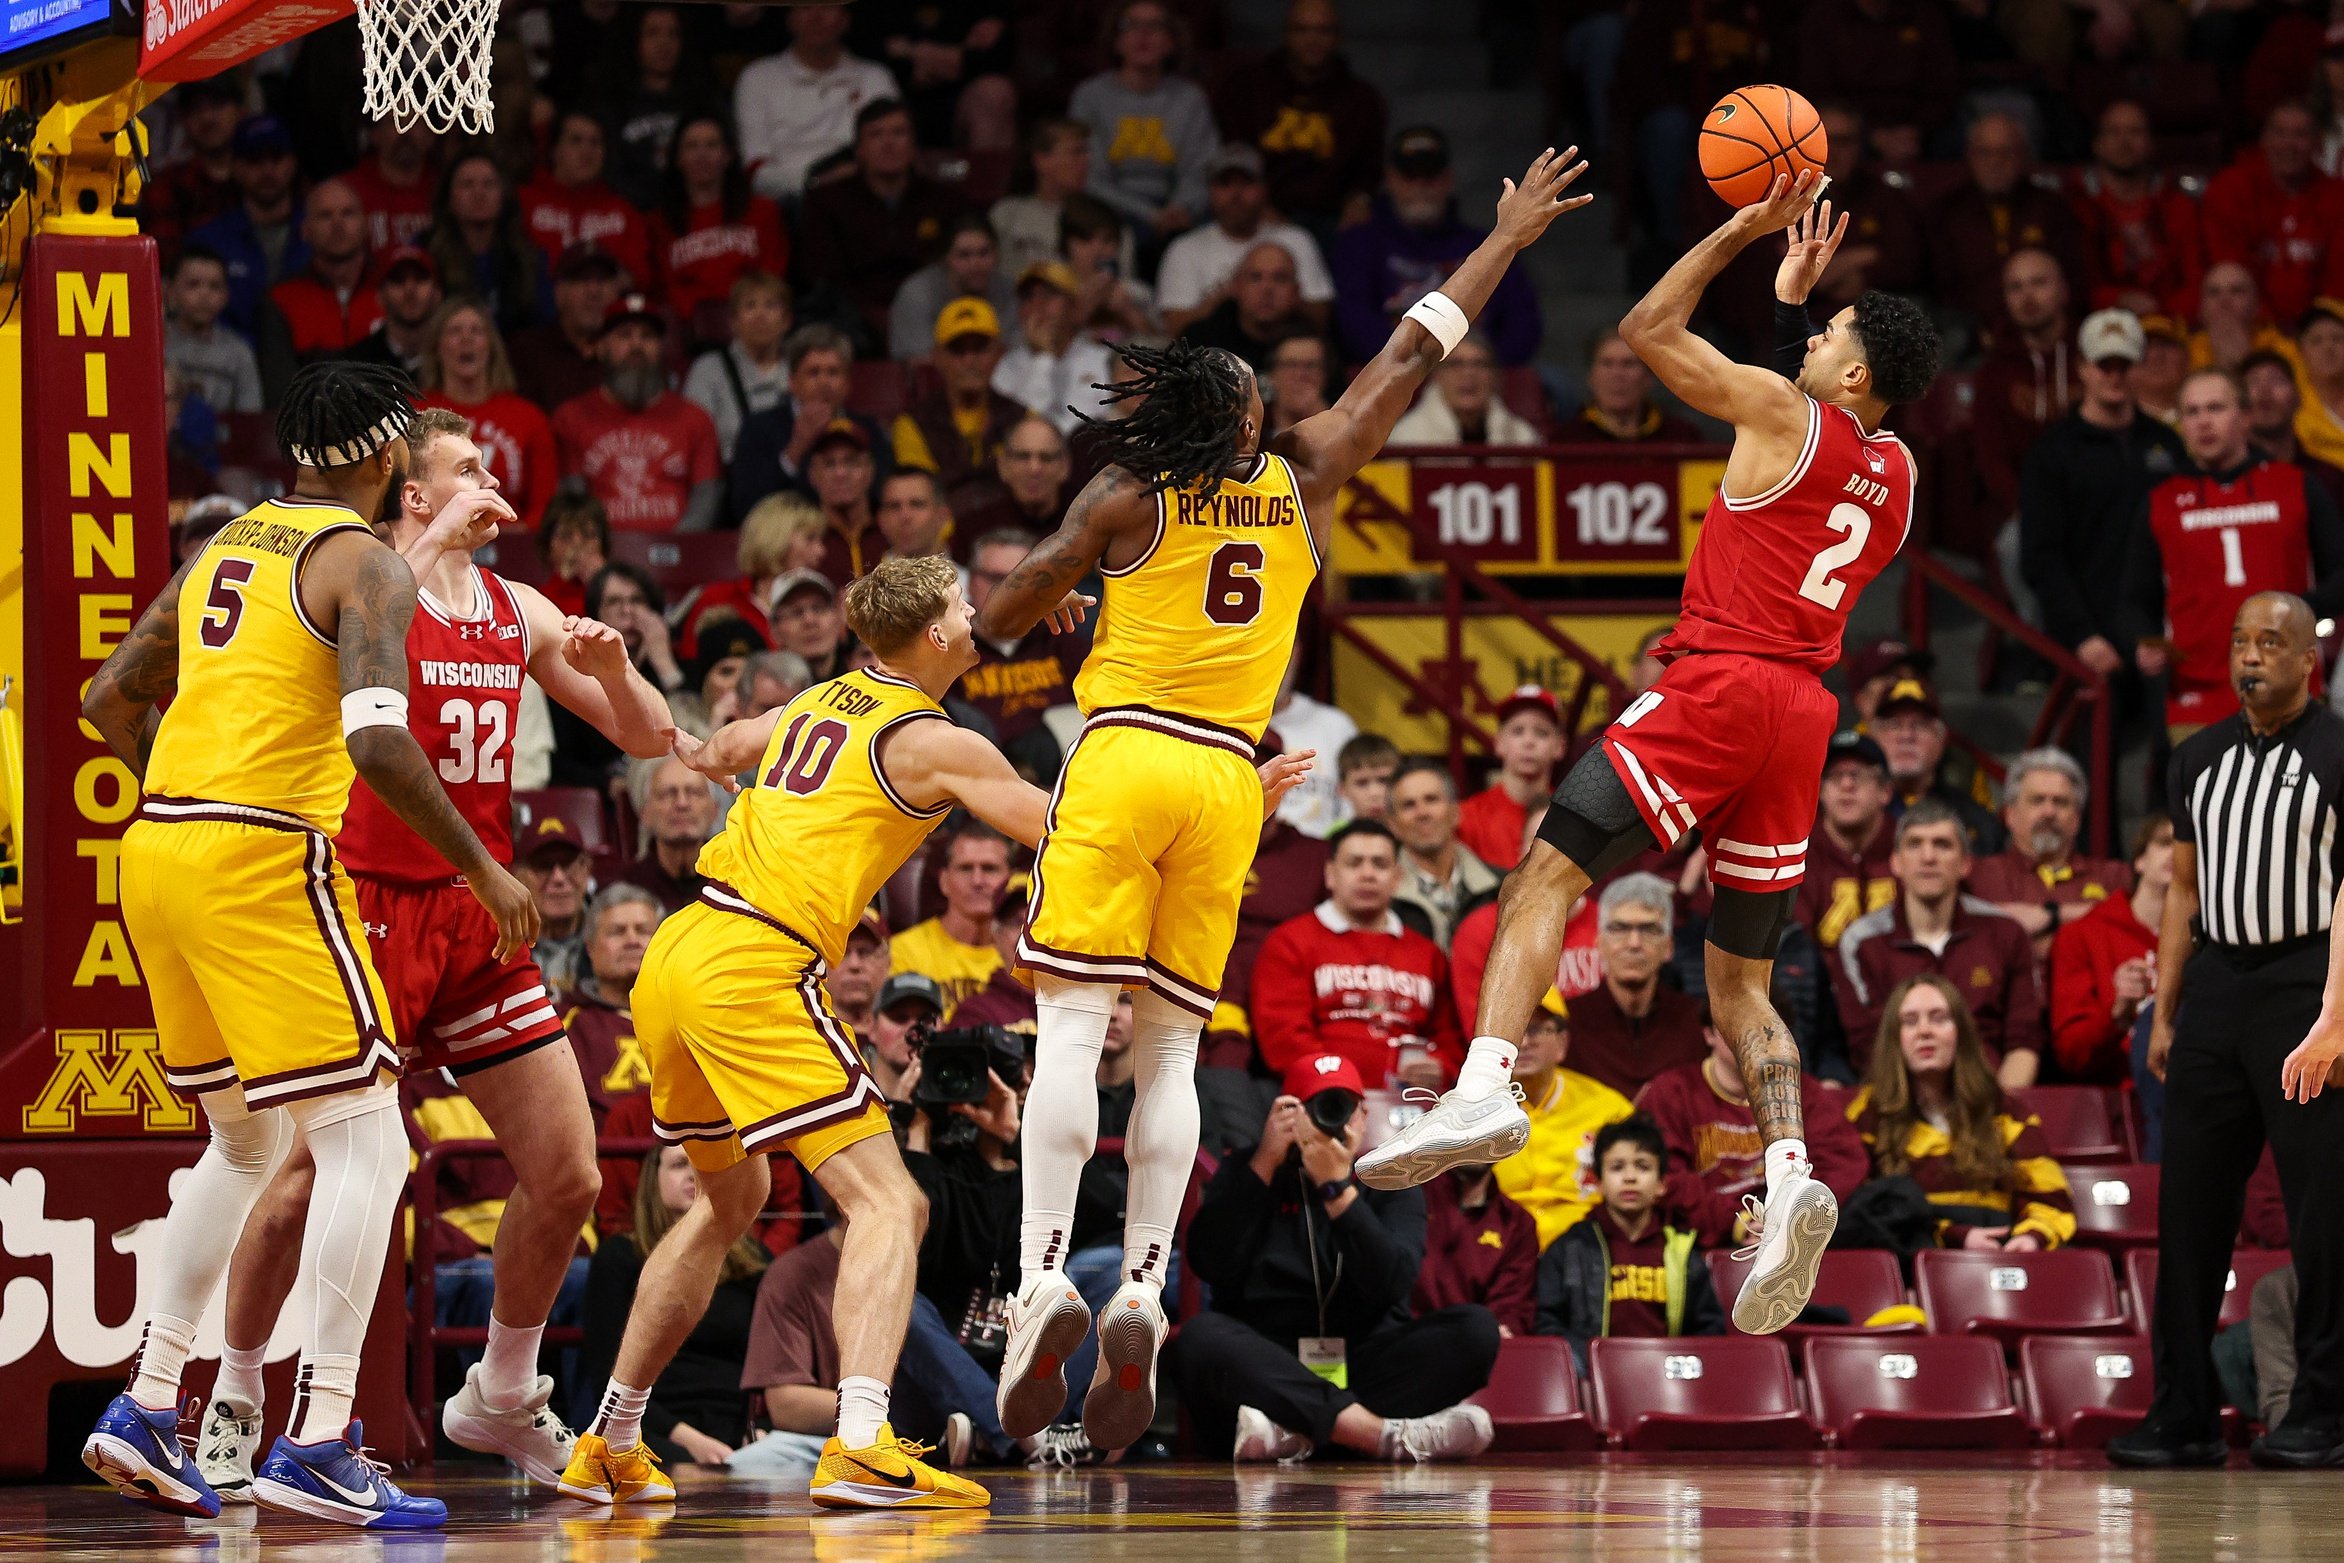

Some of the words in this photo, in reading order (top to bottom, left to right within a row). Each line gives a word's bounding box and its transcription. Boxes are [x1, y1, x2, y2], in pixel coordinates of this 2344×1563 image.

[1177, 493, 1295, 527] REYNOLDS
[1428, 482, 1520, 545] 101
[1567, 482, 1670, 545] 102
[1843, 473, 1889, 507] BOYD
[1201, 540, 1266, 627] 6
[1798, 502, 1872, 611] 2
[2221, 526, 2247, 588] 1
[56, 271, 141, 987] MINNEOTA
[200, 556, 257, 650] 5
[420, 660, 521, 689] WISCONSIN
[818, 681, 884, 717] TYSON
[438, 698, 507, 784] 32
[763, 711, 850, 797] 10
[1314, 963, 1435, 1010] WISCONSIN
[22, 1029, 197, 1133] M
[1763, 1063, 1800, 1085] PRAY
